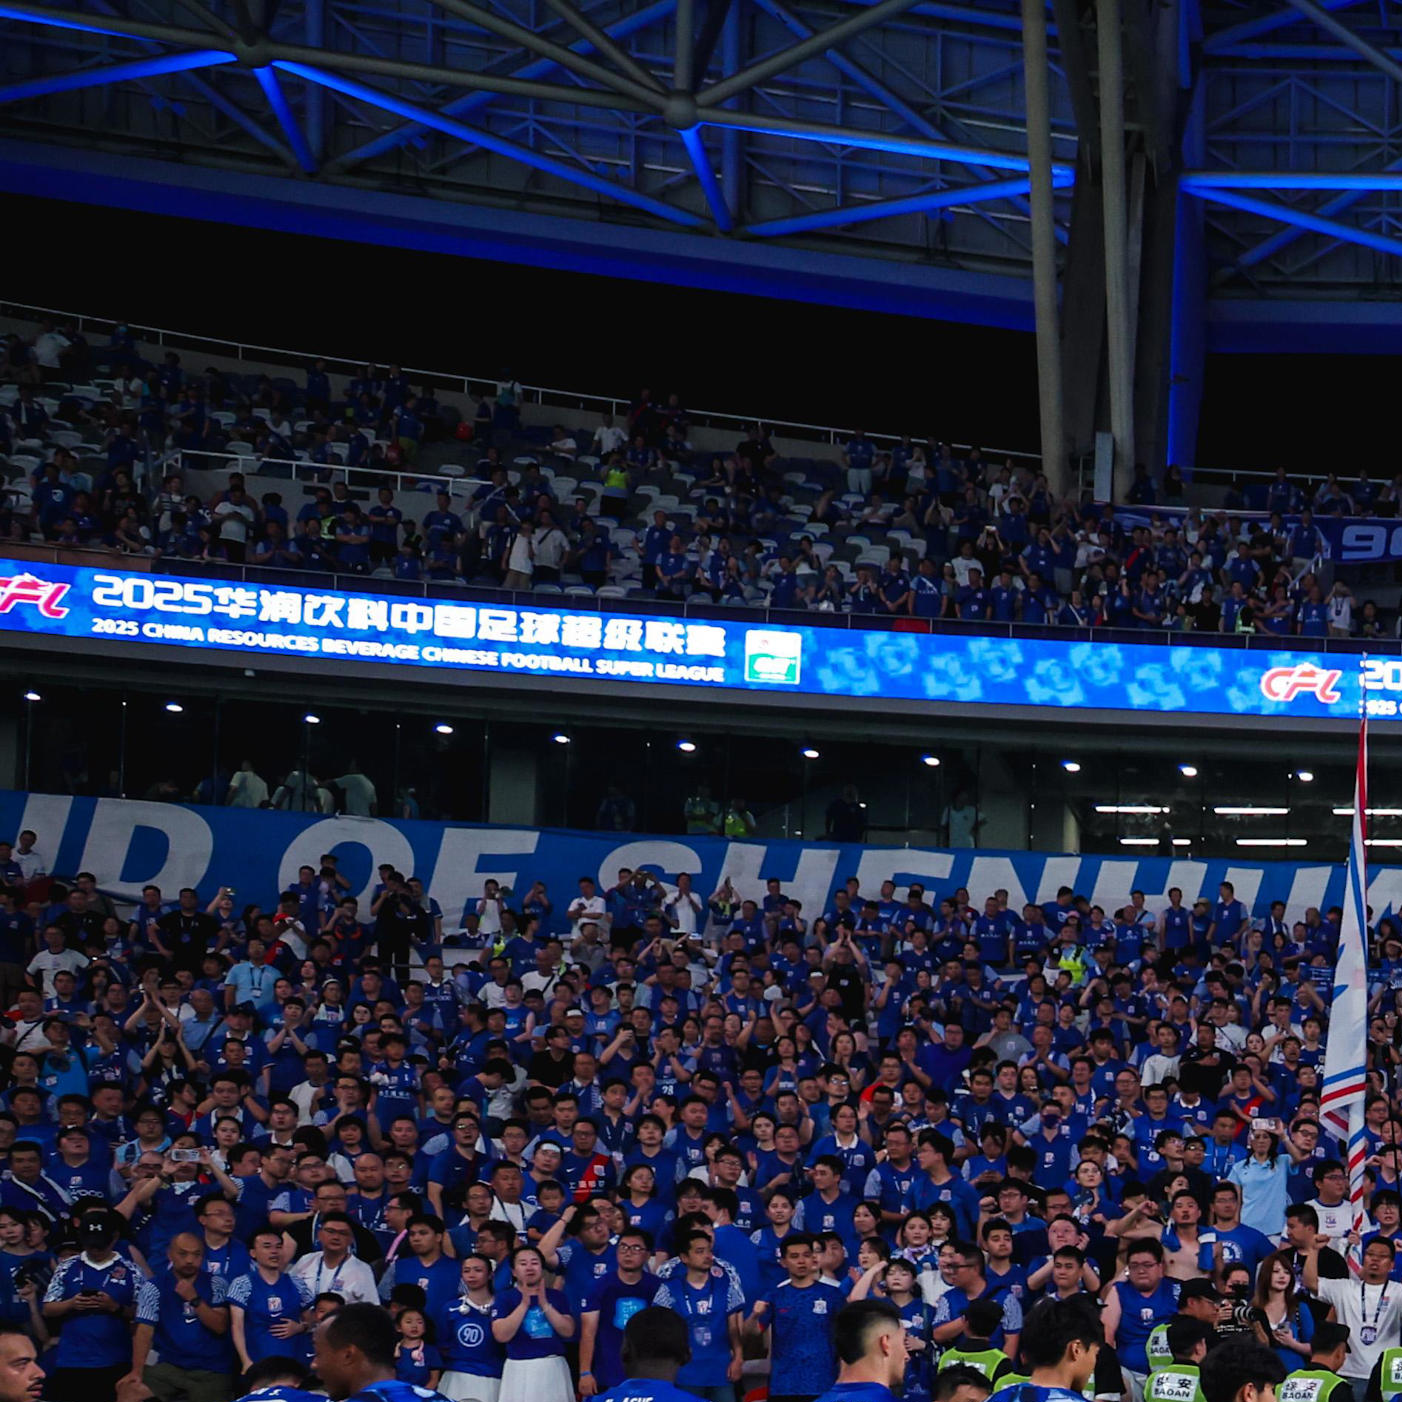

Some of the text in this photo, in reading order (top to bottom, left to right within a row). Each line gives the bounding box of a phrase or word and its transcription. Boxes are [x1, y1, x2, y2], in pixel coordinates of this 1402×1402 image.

[93, 574, 725, 656] 2025华润饮料中国足球超级联赛
[91, 618, 725, 682] 2025 CHINA RESOURCES BEVERAGE CHINESE FOOTBALL SUPER LEAGUE
[278, 816, 540, 938] OF
[463, 1327, 480, 1343] 90
[1282, 1391, 1314, 1400] BAOAN
